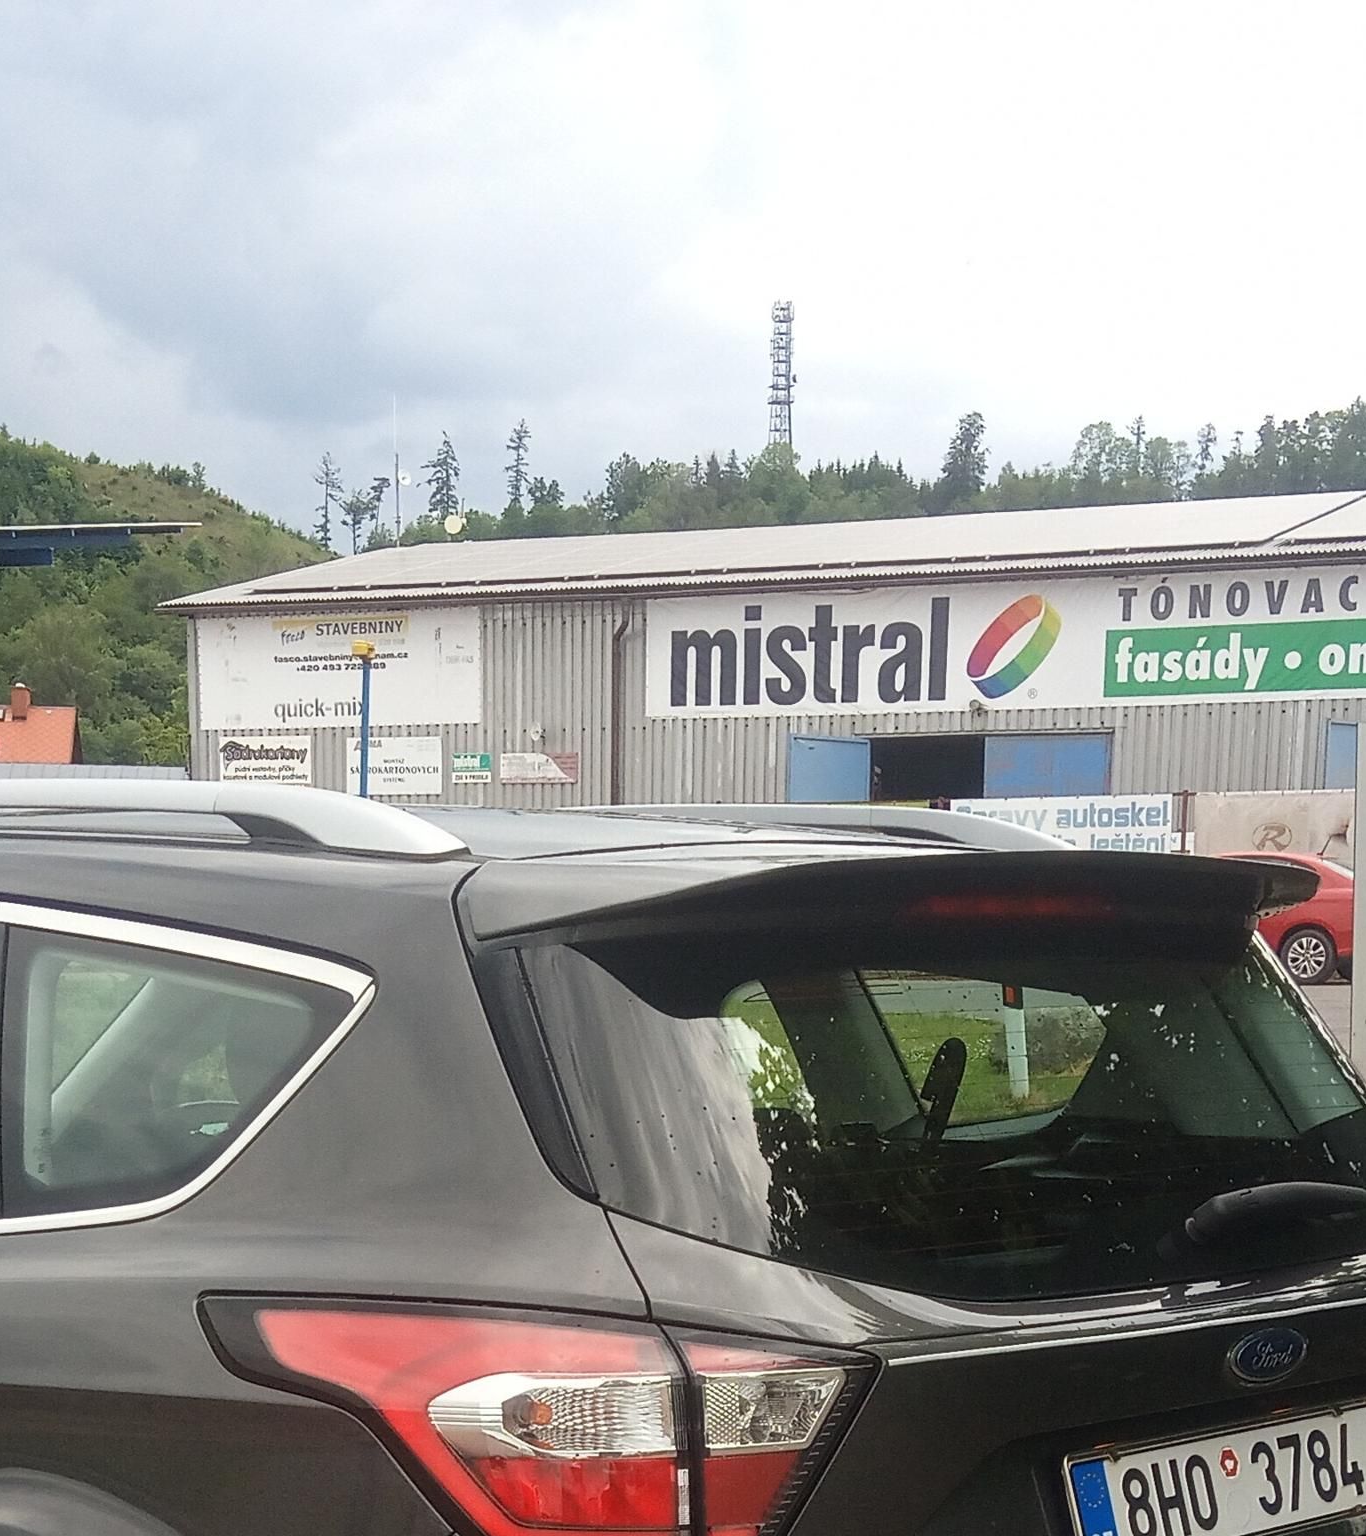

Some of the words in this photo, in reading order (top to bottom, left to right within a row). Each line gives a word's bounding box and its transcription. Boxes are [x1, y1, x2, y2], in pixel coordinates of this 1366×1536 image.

[316, 620, 403, 636] STAVEBNINY
[670, 597, 951, 707] mistral
[1115, 632, 1270, 690] fasády
[1056, 801, 1169, 828] autoskel
[1251, 1424, 1365, 1516] 3784
